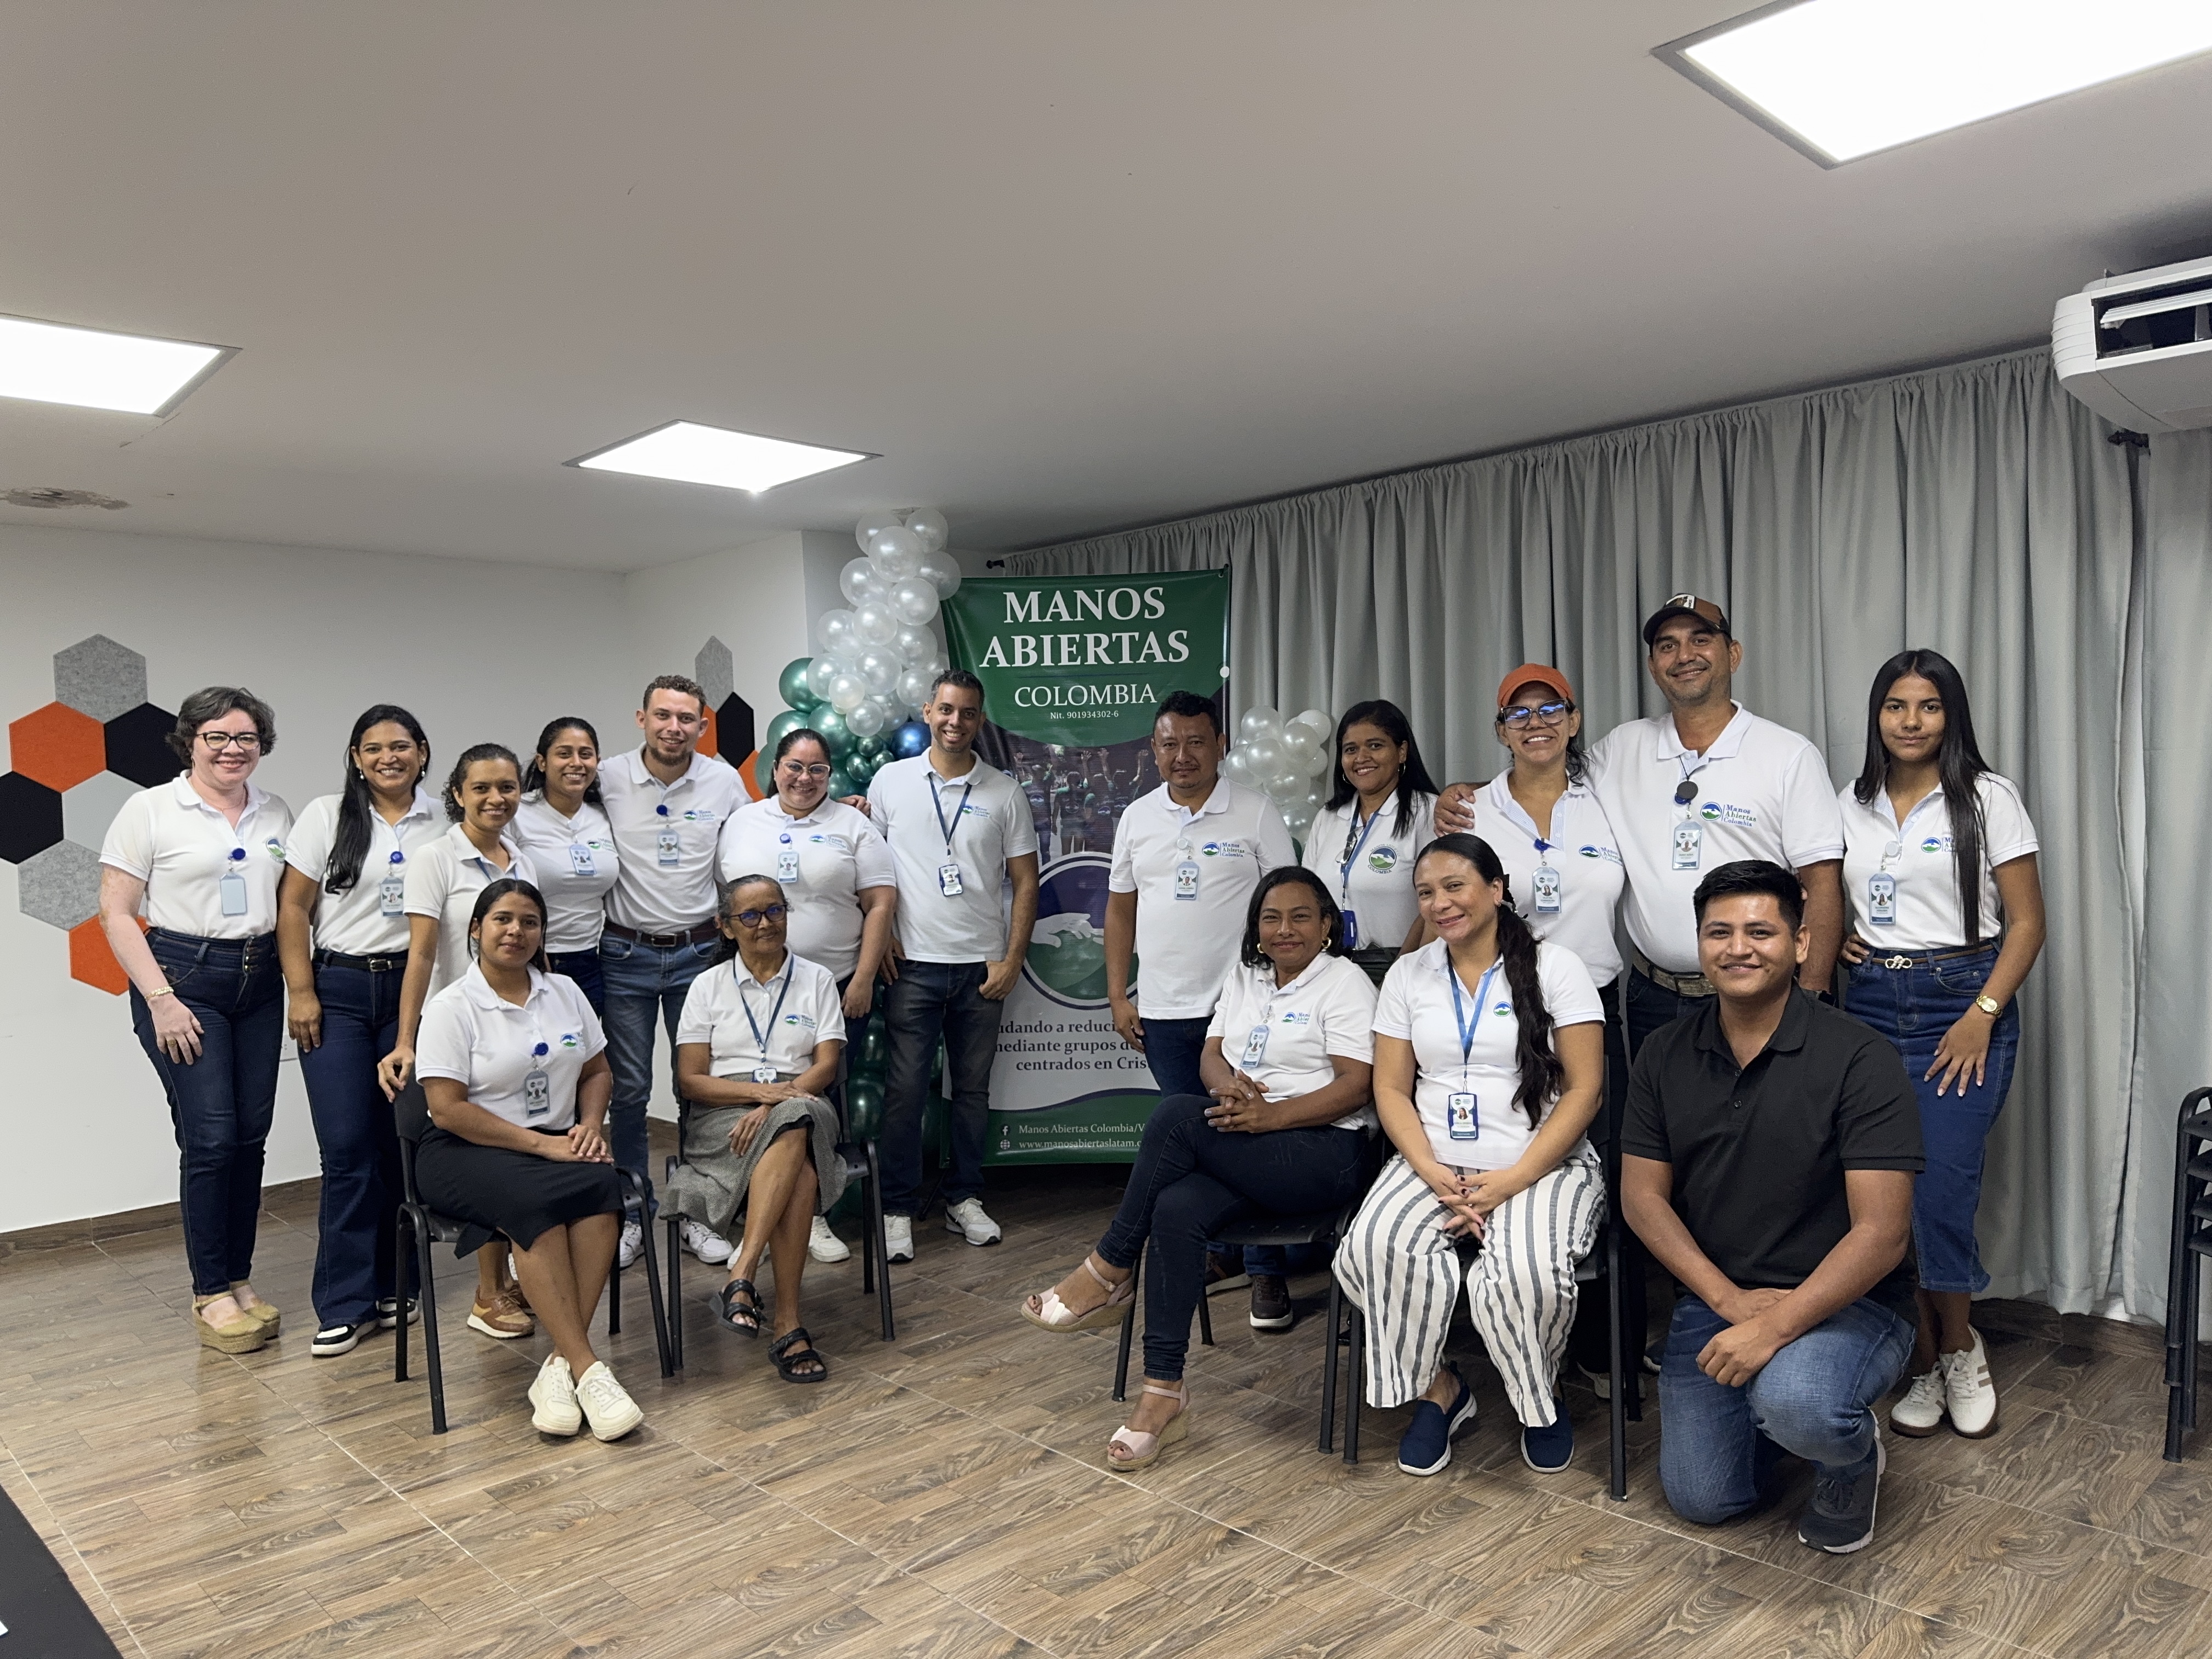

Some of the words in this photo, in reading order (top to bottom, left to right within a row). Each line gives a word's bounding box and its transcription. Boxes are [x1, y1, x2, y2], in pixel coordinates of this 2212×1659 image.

[1003, 587, 1165, 623] MANOS
[979, 630, 1189, 667] ABIERTAS
[1014, 683, 1157, 707] COLOMBIA
[1066, 710, 1119, 719] 901934302-6
[1726, 804, 1751, 814] Manos
[1724, 817, 1752, 827] Colombia
[1725, 811, 1756, 822] Abiertas
[1368, 865, 1392, 874] COLOMBIA
[998, 1020, 1053, 1033] udando
[1056, 1024, 1064, 1032] a
[1069, 1019, 1115, 1032] reduci
[1064, 1041, 1116, 1054] grupos
[1016, 1057, 1091, 1070] centrados
[1094, 1060, 1113, 1069] en
[1117, 1057, 1147, 1069] Cris
[1019, 1125, 1049, 1133] Manos
[1051, 1124, 1088, 1133] Abiertas
[1091, 1123, 1146, 1133] Colombia/V
[1019, 1138, 1142, 1148] www.manosabiertaslatam.c
